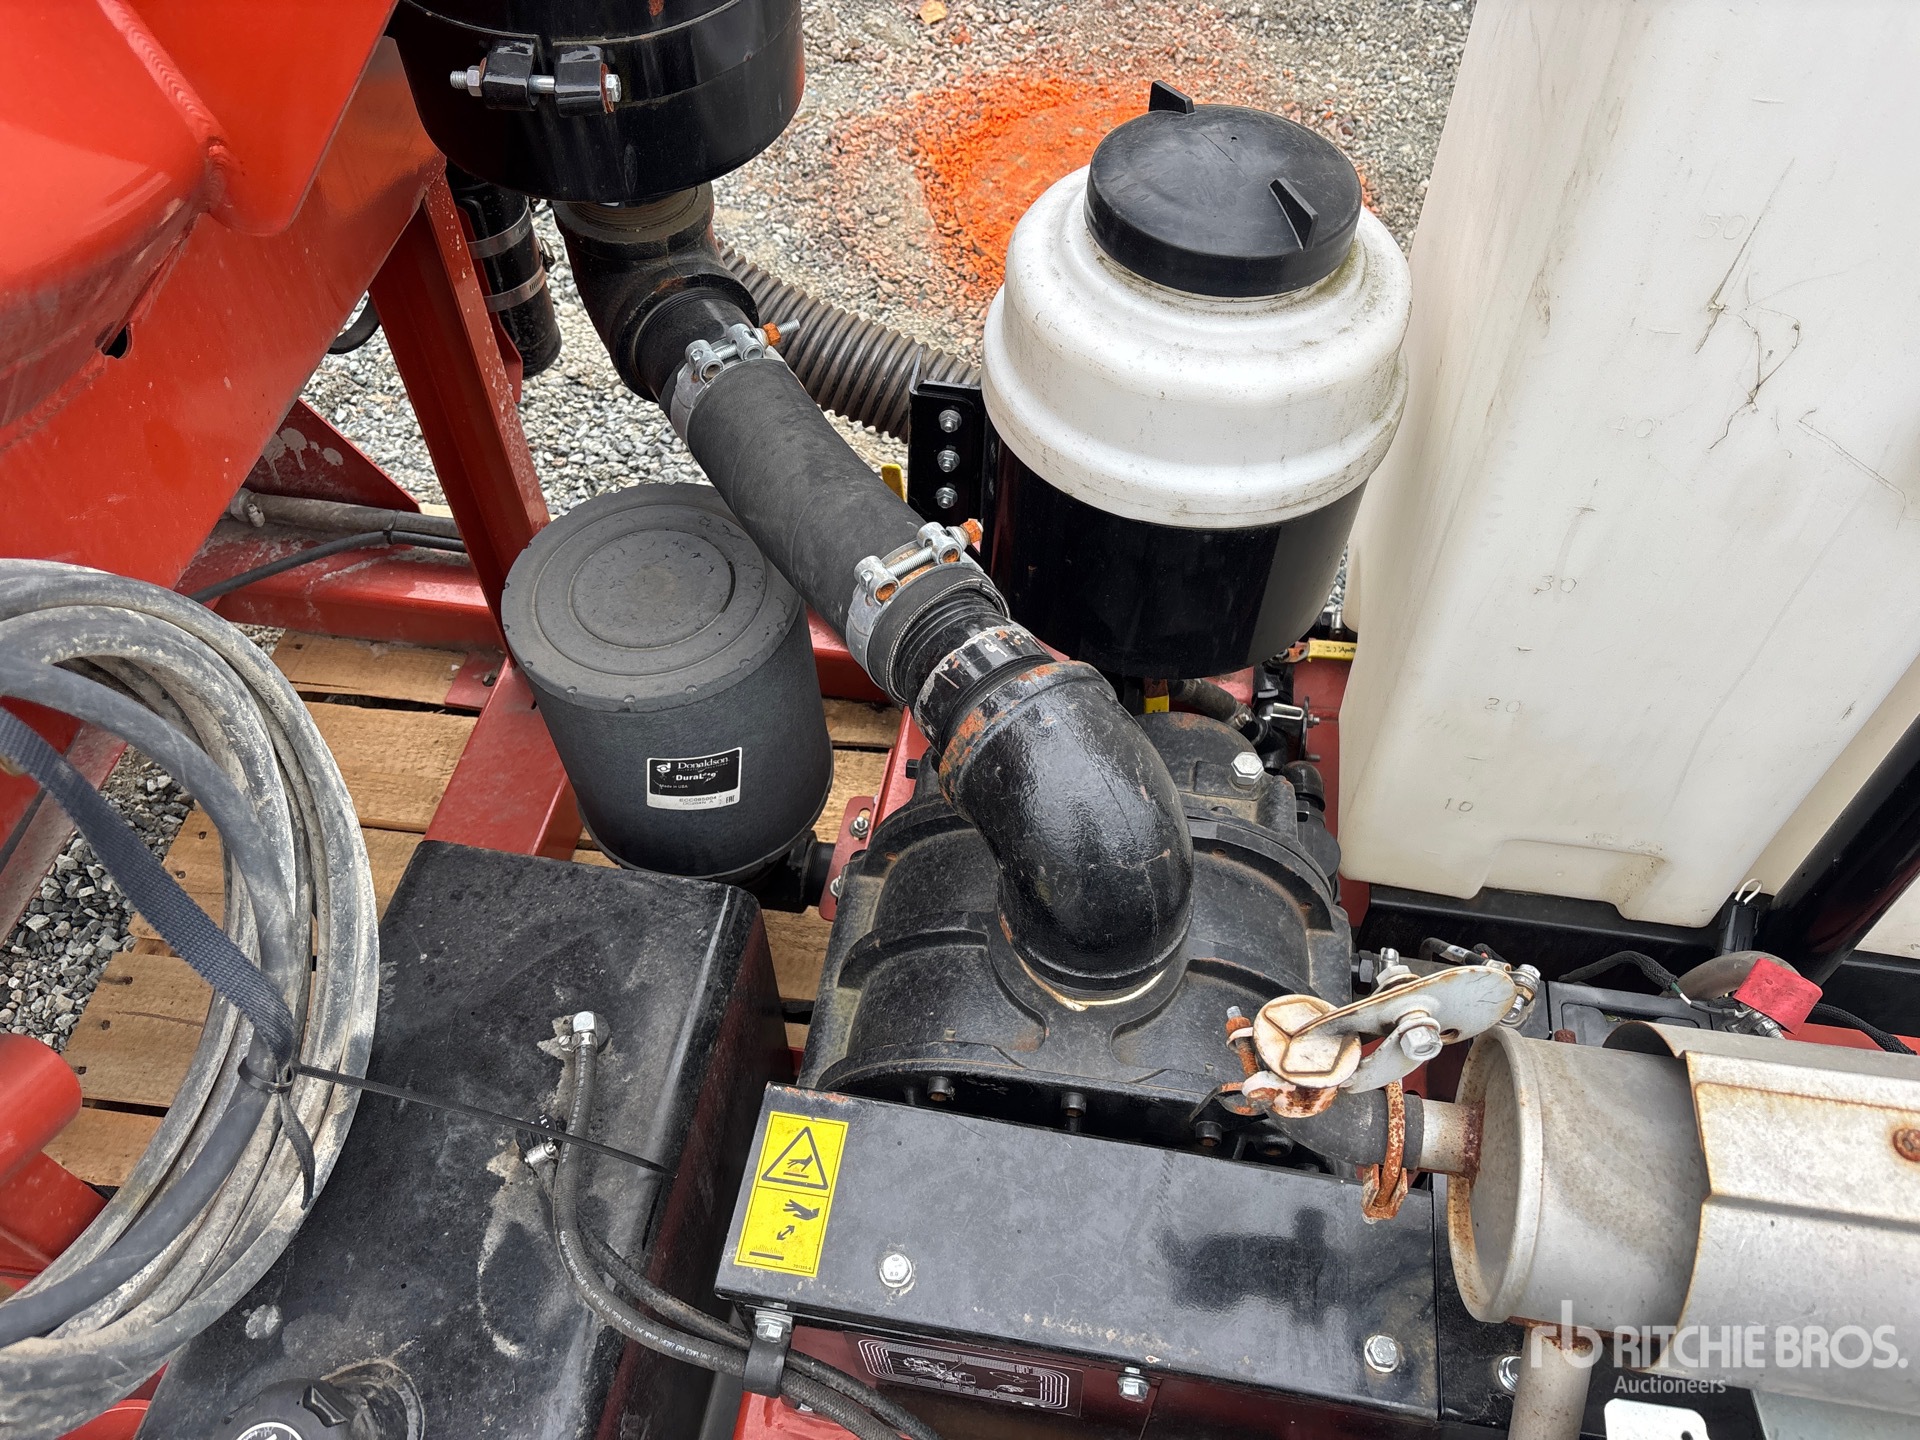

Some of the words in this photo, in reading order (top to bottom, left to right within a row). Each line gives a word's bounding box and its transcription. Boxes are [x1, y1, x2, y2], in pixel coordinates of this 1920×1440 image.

[1535, 574, 1578, 594] 30
[1484, 697, 1522, 714] 20
[677, 757, 729, 770] Donaldson
[1444, 798, 1474, 813] 10
